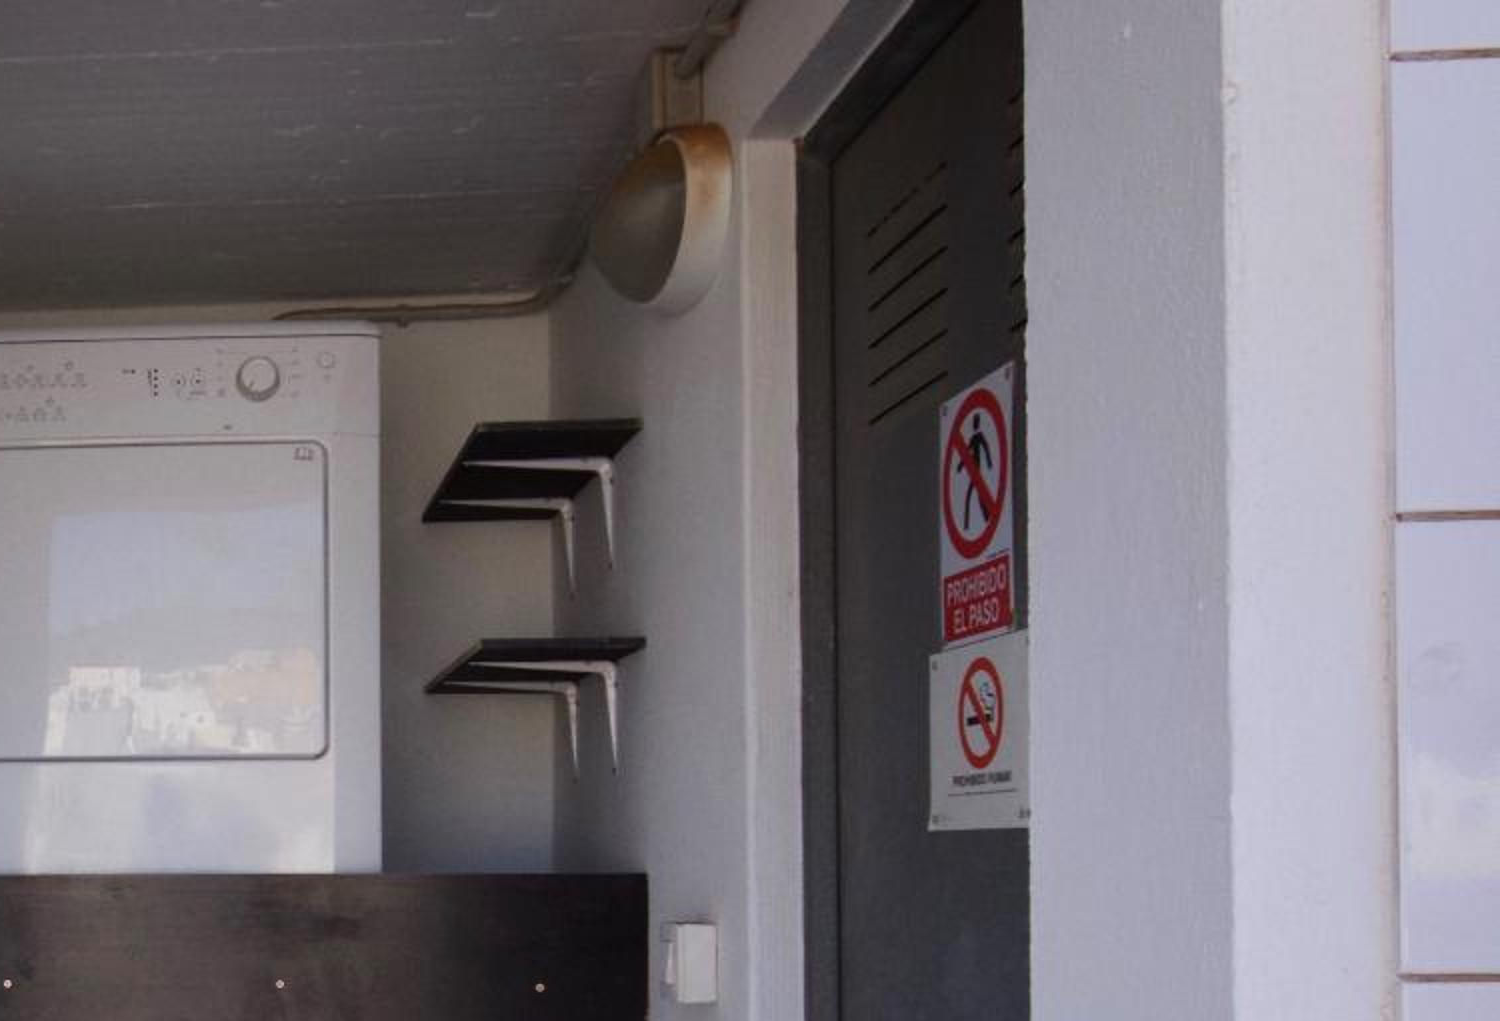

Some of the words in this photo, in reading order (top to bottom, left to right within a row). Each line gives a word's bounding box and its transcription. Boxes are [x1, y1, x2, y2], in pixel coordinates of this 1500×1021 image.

[947, 563, 1007, 607] PROHIBIDO
[953, 608, 967, 635] EL
[969, 597, 999, 629] PASO
